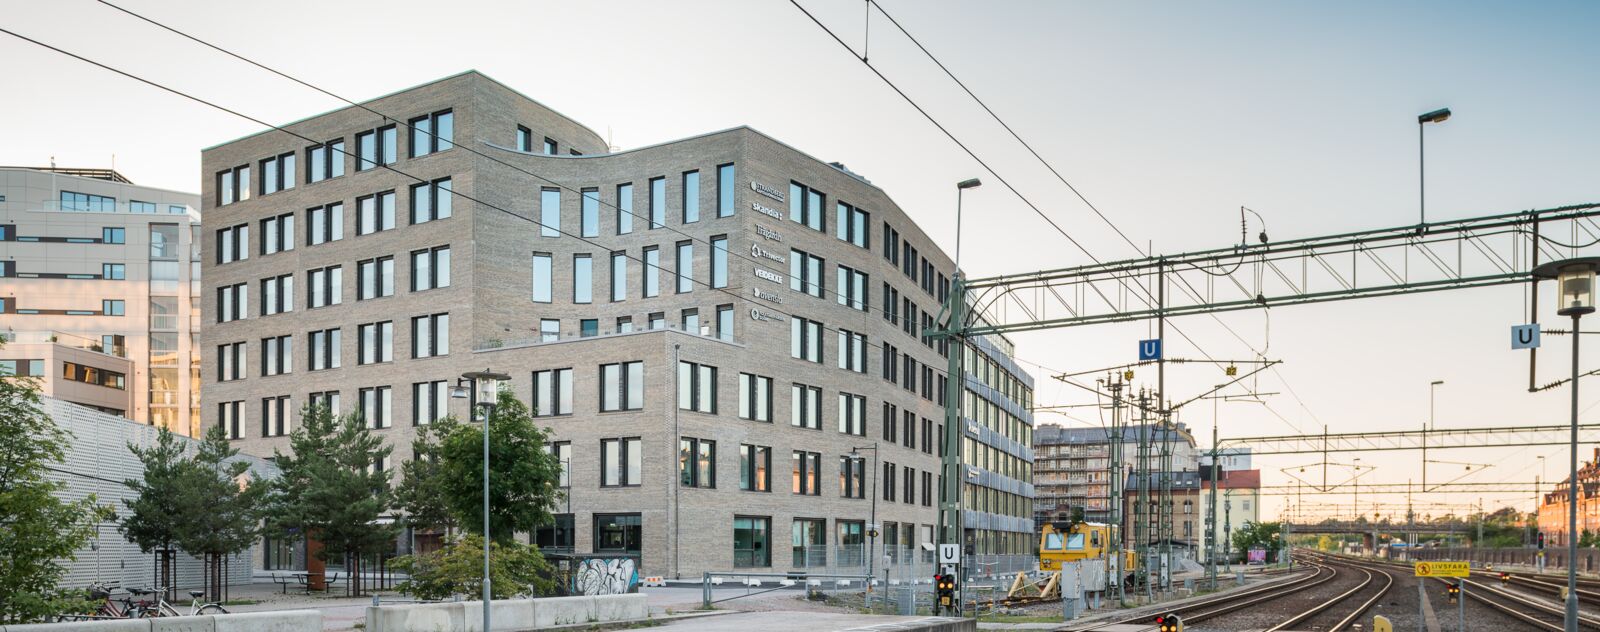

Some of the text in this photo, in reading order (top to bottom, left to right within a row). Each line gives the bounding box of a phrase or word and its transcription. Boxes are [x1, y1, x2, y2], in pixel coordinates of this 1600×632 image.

[1519, 328, 1532, 344] U
[1145, 342, 1155, 356] U
[945, 547, 953, 559] U
